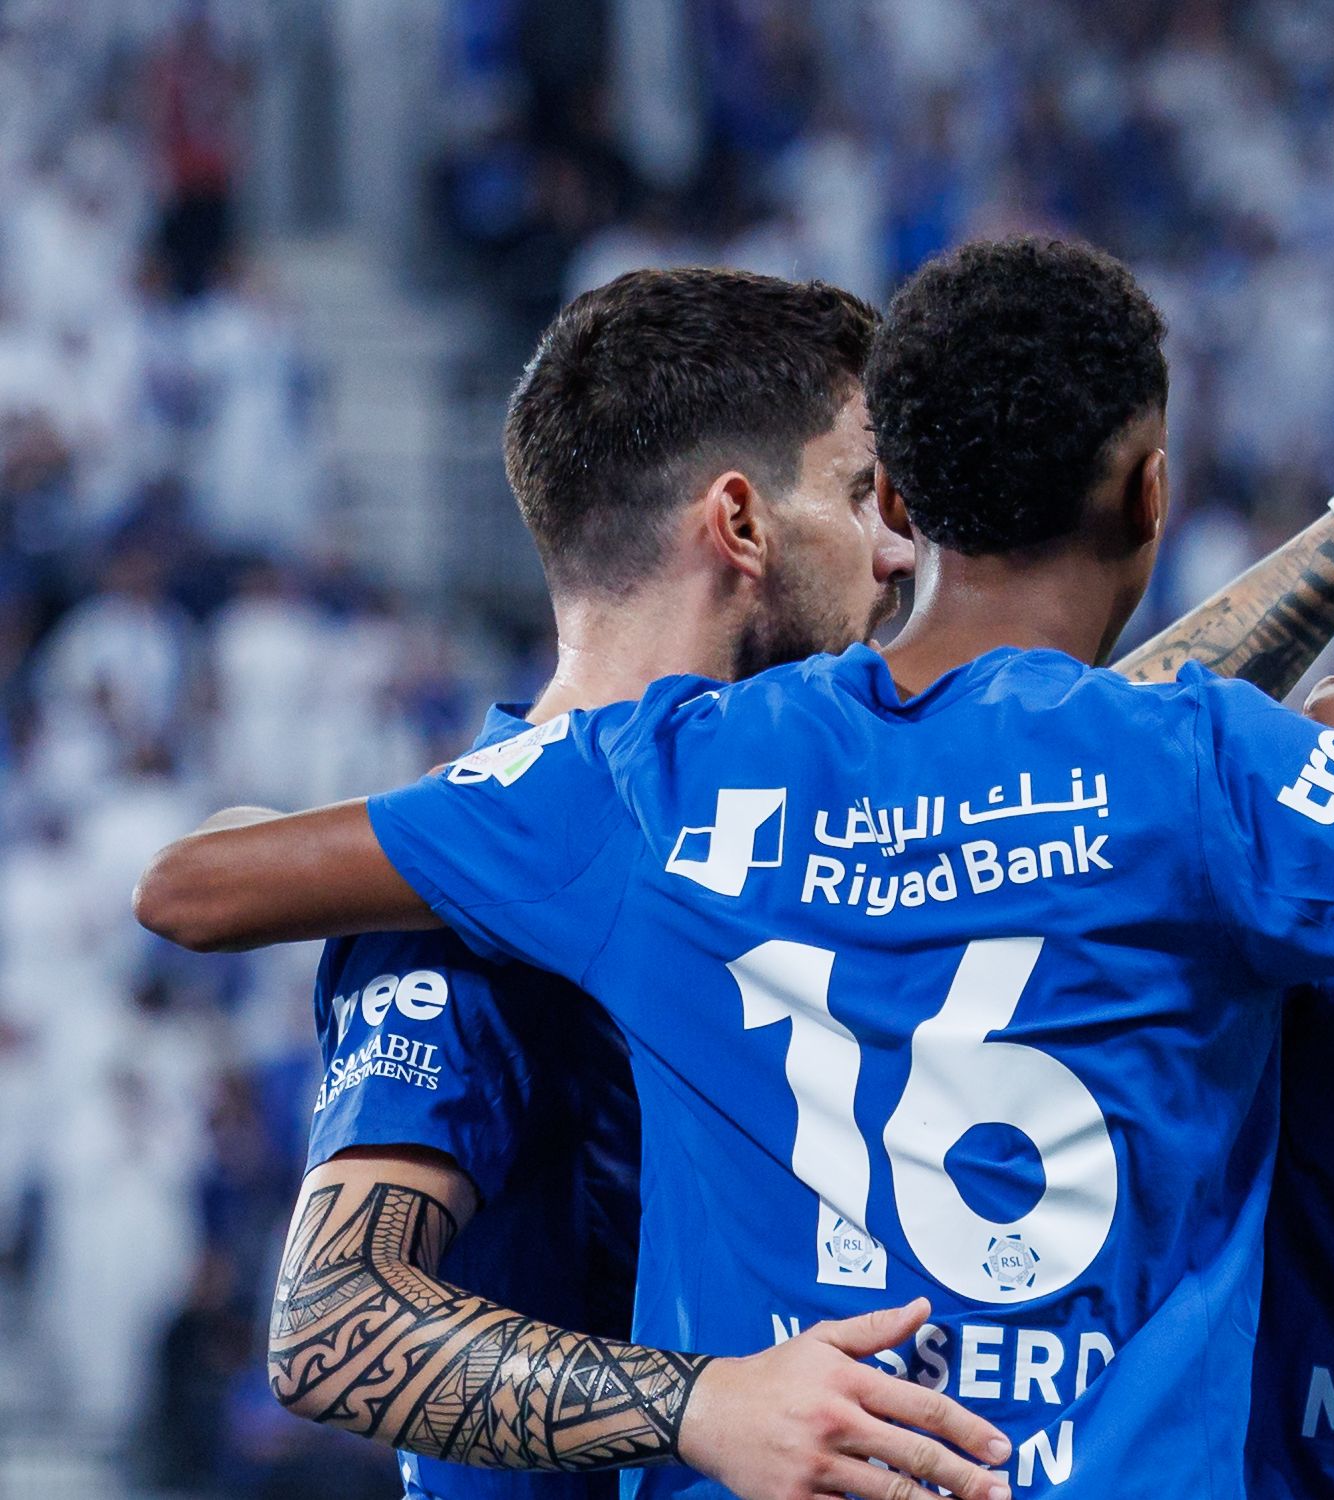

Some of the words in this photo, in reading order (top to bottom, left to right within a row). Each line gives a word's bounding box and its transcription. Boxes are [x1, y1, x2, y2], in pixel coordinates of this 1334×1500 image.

[960, 767, 1109, 826] بنك
[800, 853, 957, 916] Riyad
[962, 825, 1114, 895] Bank
[725, 936, 1118, 1304] 16
[843, 1238, 863, 1251] RSL
[1001, 1256, 1023, 1268] RSL
